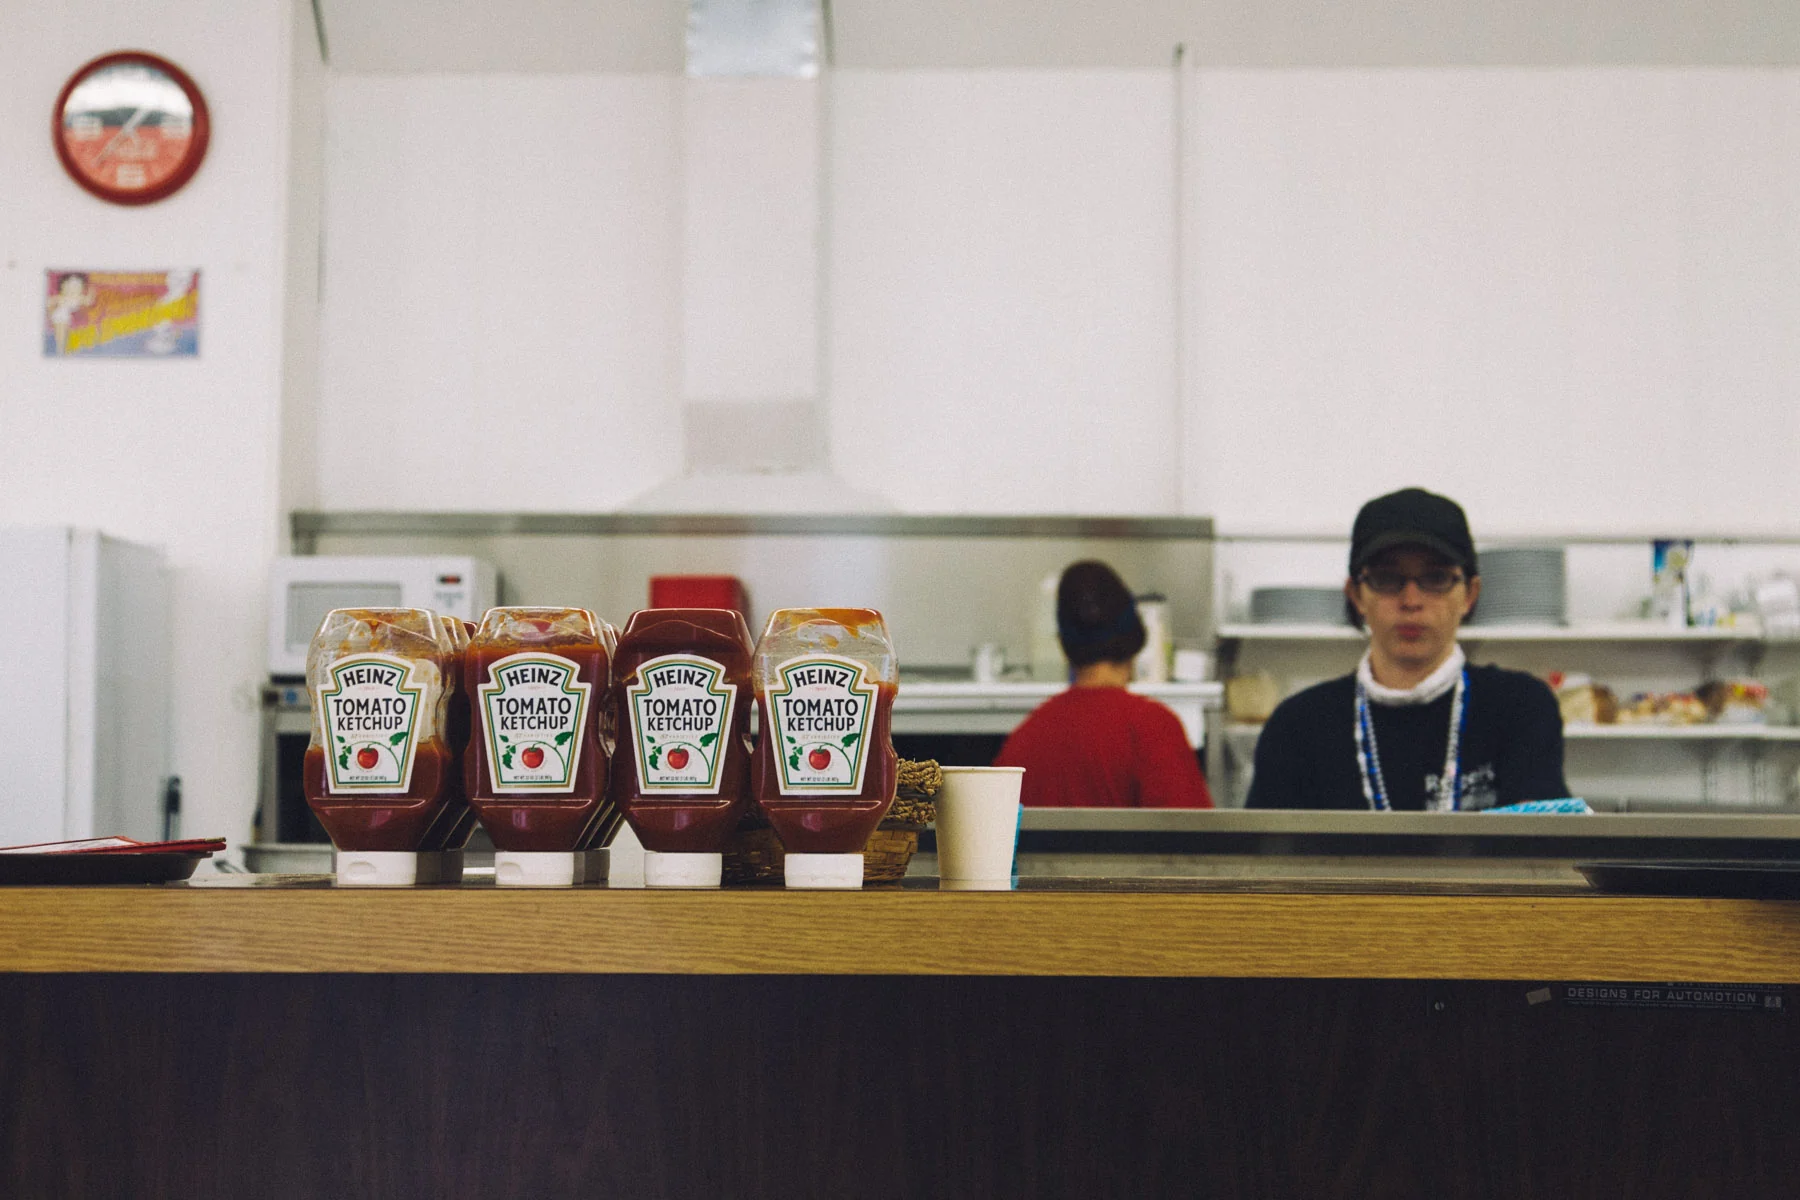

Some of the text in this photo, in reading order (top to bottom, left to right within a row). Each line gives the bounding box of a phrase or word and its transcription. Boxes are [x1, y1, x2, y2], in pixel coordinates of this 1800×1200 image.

[342, 668, 397, 688] HEINZ
[506, 668, 562, 687] HEINZ
[653, 669, 708, 688] HEINZ
[792, 669, 849, 688] HEINZ
[334, 698, 406, 716] TOMATO
[496, 697, 572, 716] TOMATO
[644, 699, 717, 717] TOMATO
[783, 699, 858, 717] TOMATO
[337, 716, 403, 731] KETCHUP
[500, 715, 568, 730] KETCHUP
[647, 717, 713, 731] KETCHUP
[787, 717, 855, 731] KETCHUP
[1568, 987, 1627, 999] DESIGNS
[1634, 989, 1660, 999] FOR
[1667, 990, 1756, 1002] AUTOMOTION
